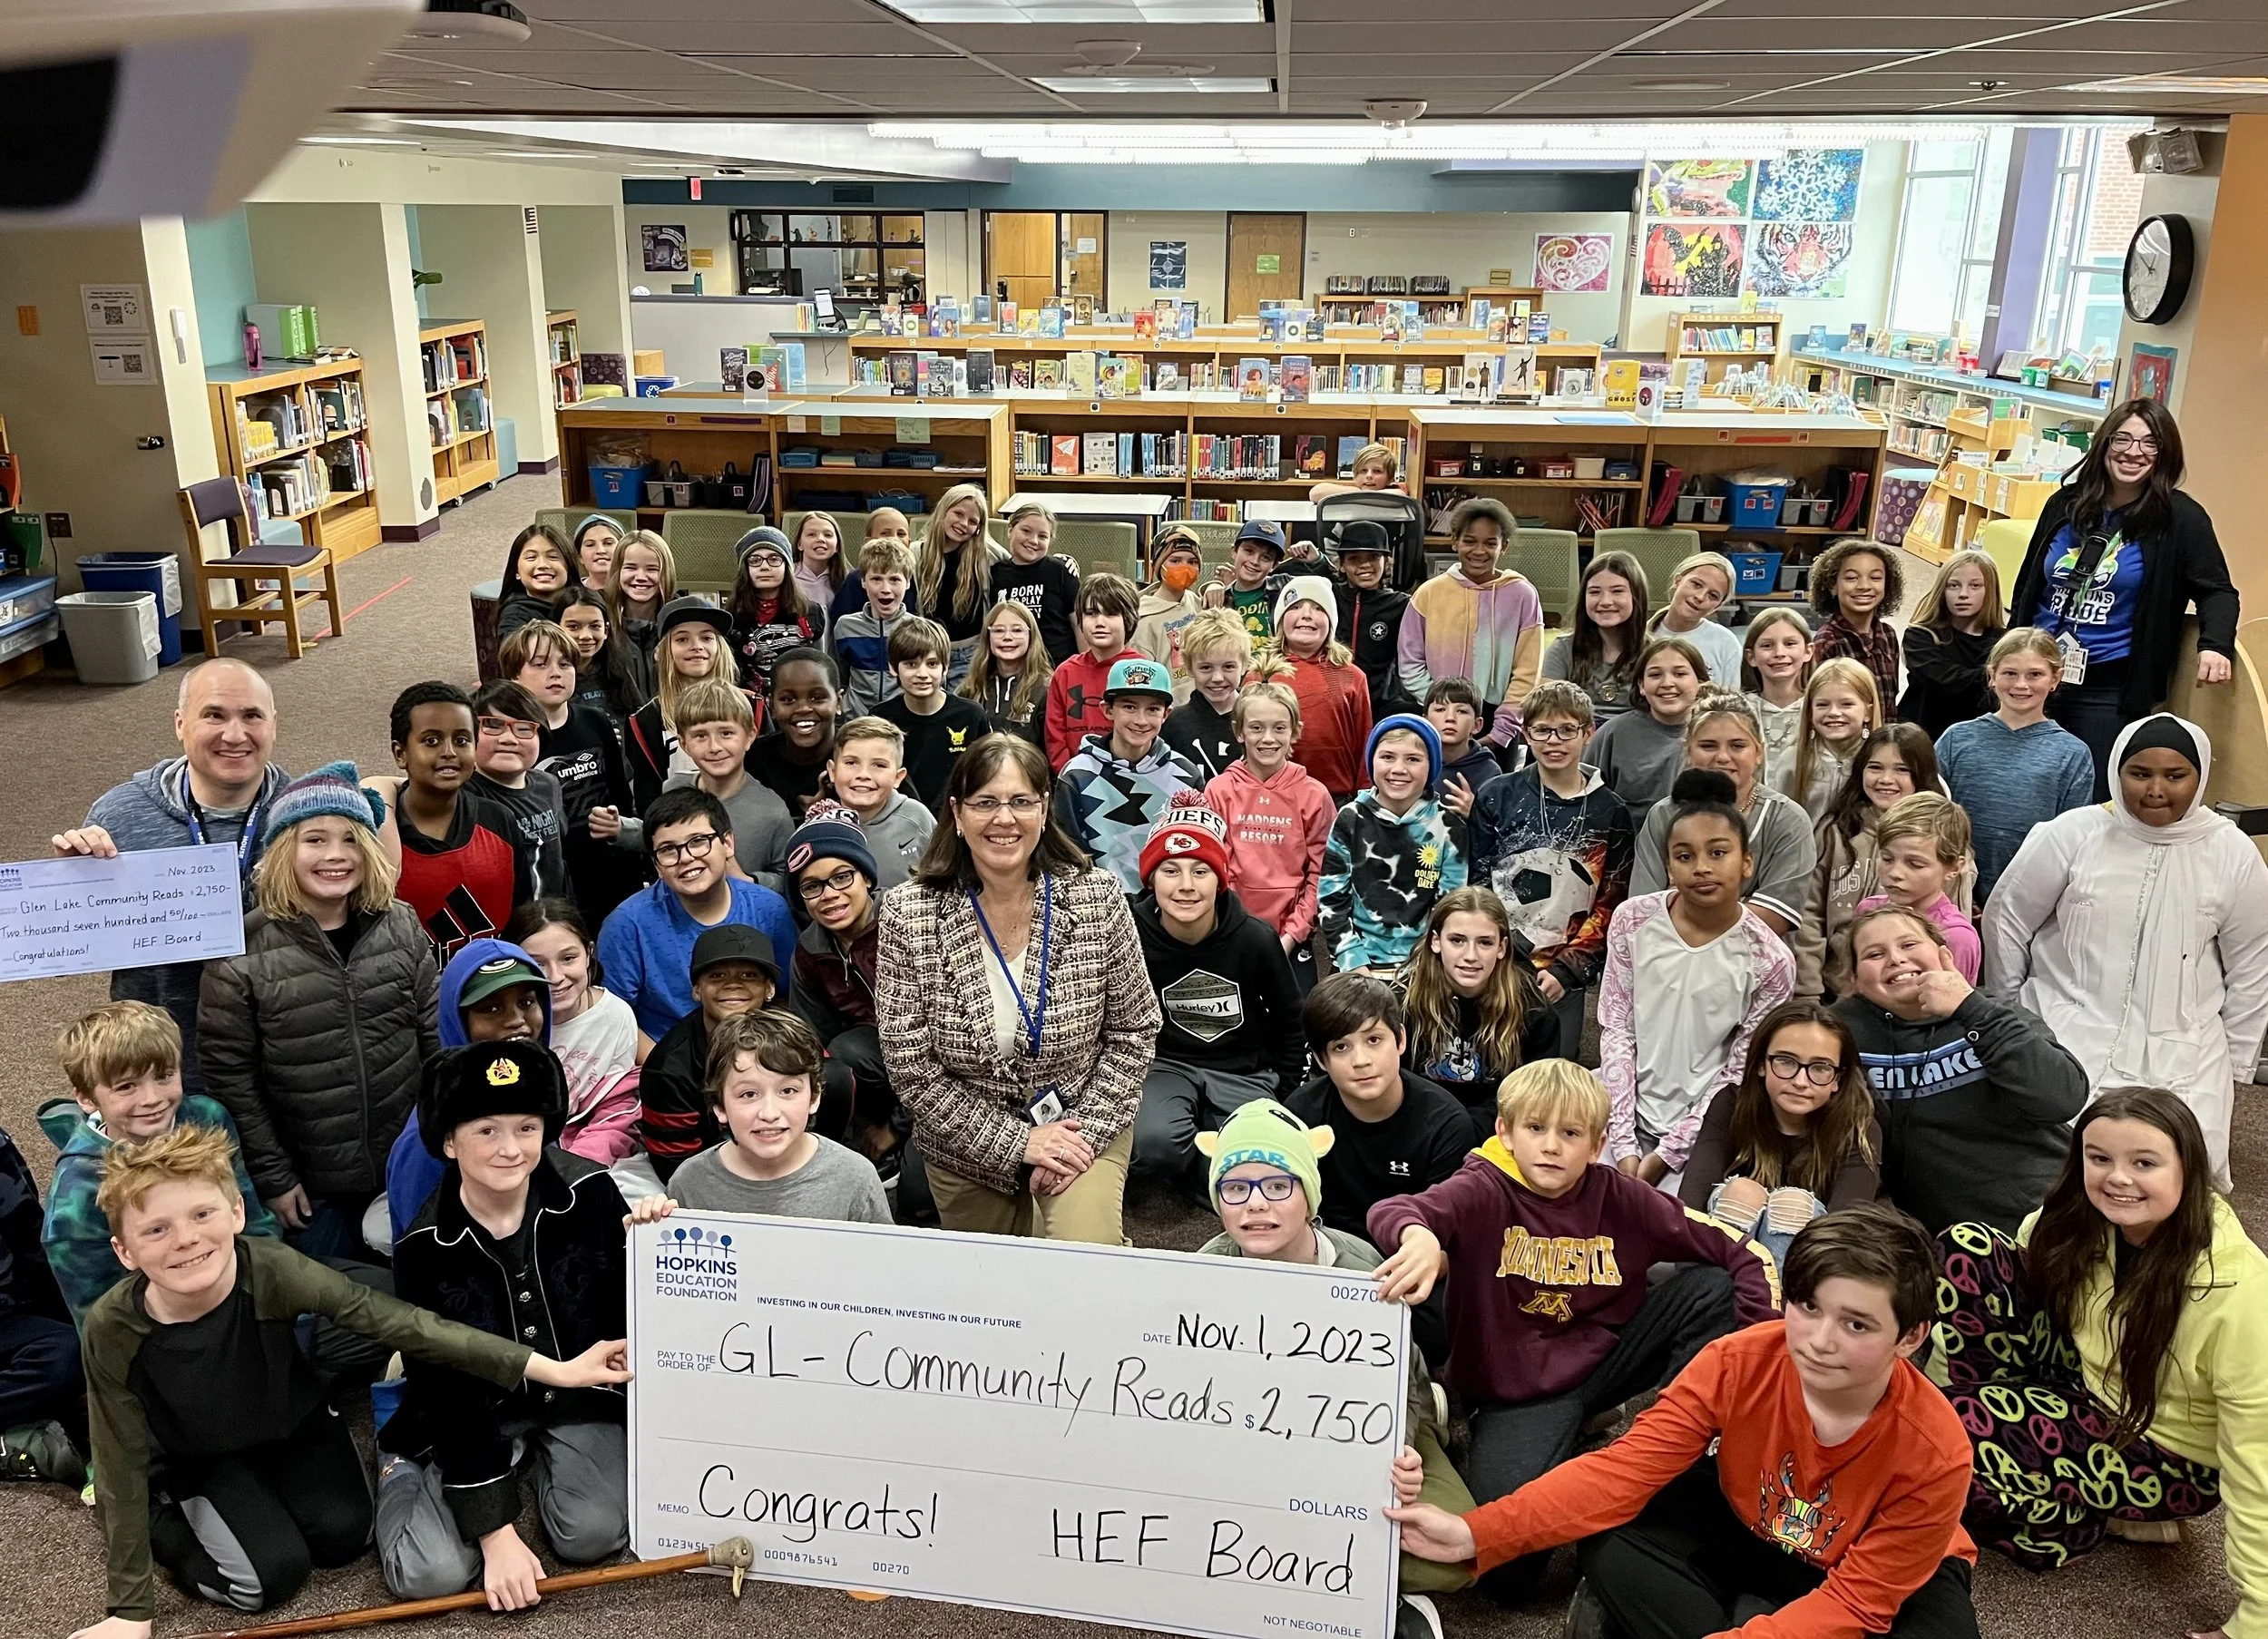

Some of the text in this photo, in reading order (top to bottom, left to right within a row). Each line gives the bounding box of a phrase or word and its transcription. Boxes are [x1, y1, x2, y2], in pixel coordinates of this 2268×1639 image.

[1011, 584, 1044, 598] BORN
[1022, 595, 1041, 605] PLAY
[557, 759, 598, 778] umbro
[1236, 814, 1293, 827] MADDENS
[1239, 831, 1285, 844] RESORT
[239, 835, 249, 859] HOUSE
[900, 846, 918, 856] AIR
[168, 865, 216, 877] Nov 2023
[1414, 869, 1440, 882] GOLDEN
[1417, 877, 1434, 889] DAZE
[20, 901, 46, 914] Glen
[54, 898, 82, 911] Lake
[87, 892, 148, 906] Community
[152, 889, 184, 901] Reads
[0, 925, 20, 938] Two
[24, 920, 70, 936] thousand
[73, 922, 100, 932] seven
[104, 913, 147, 927] hundred
[150, 911, 167, 922] and
[132, 931, 201, 949] HEF Board
[13, 944, 89, 964] Congratulations!
[1176, 1003, 1216, 1013] Hurley
[1911, 1048, 1983, 1087] LAKE
[1218, 1149, 1291, 1174] STAR
[656, 1255, 737, 1275] HOPKINS
[656, 1273, 737, 1289] EDUCATION
[656, 1286, 737, 1302] FOUNDATION
[1331, 1285, 1379, 1303] 00270
[757, 1296, 1022, 1329] INVESTING IN OUR CHILDREN, INVESTING IN OUR FUTURE
[1142, 1332, 1172, 1344] DATE
[1260, 1314, 1273, 1361] 1,
[1286, 1322, 1395, 1367] 2023
[657, 1351, 716, 1364] PAY TO THE
[657, 1361, 711, 1372] ORDER OF
[846, 1330, 1092, 1439] Community
[1111, 1356, 1234, 1424] Reads
[657, 1503, 689, 1515] MEMO
[699, 1464, 938, 1548] Congrats!
[1289, 1498, 1369, 1521] DOLLARS
[1053, 1507, 1354, 1595] HEF Board
[764, 1549, 838, 1567] 0009876541
[873, 1561, 910, 1576] 00270
[1263, 1615, 1363, 1638] NOT NEGOTIABLE
